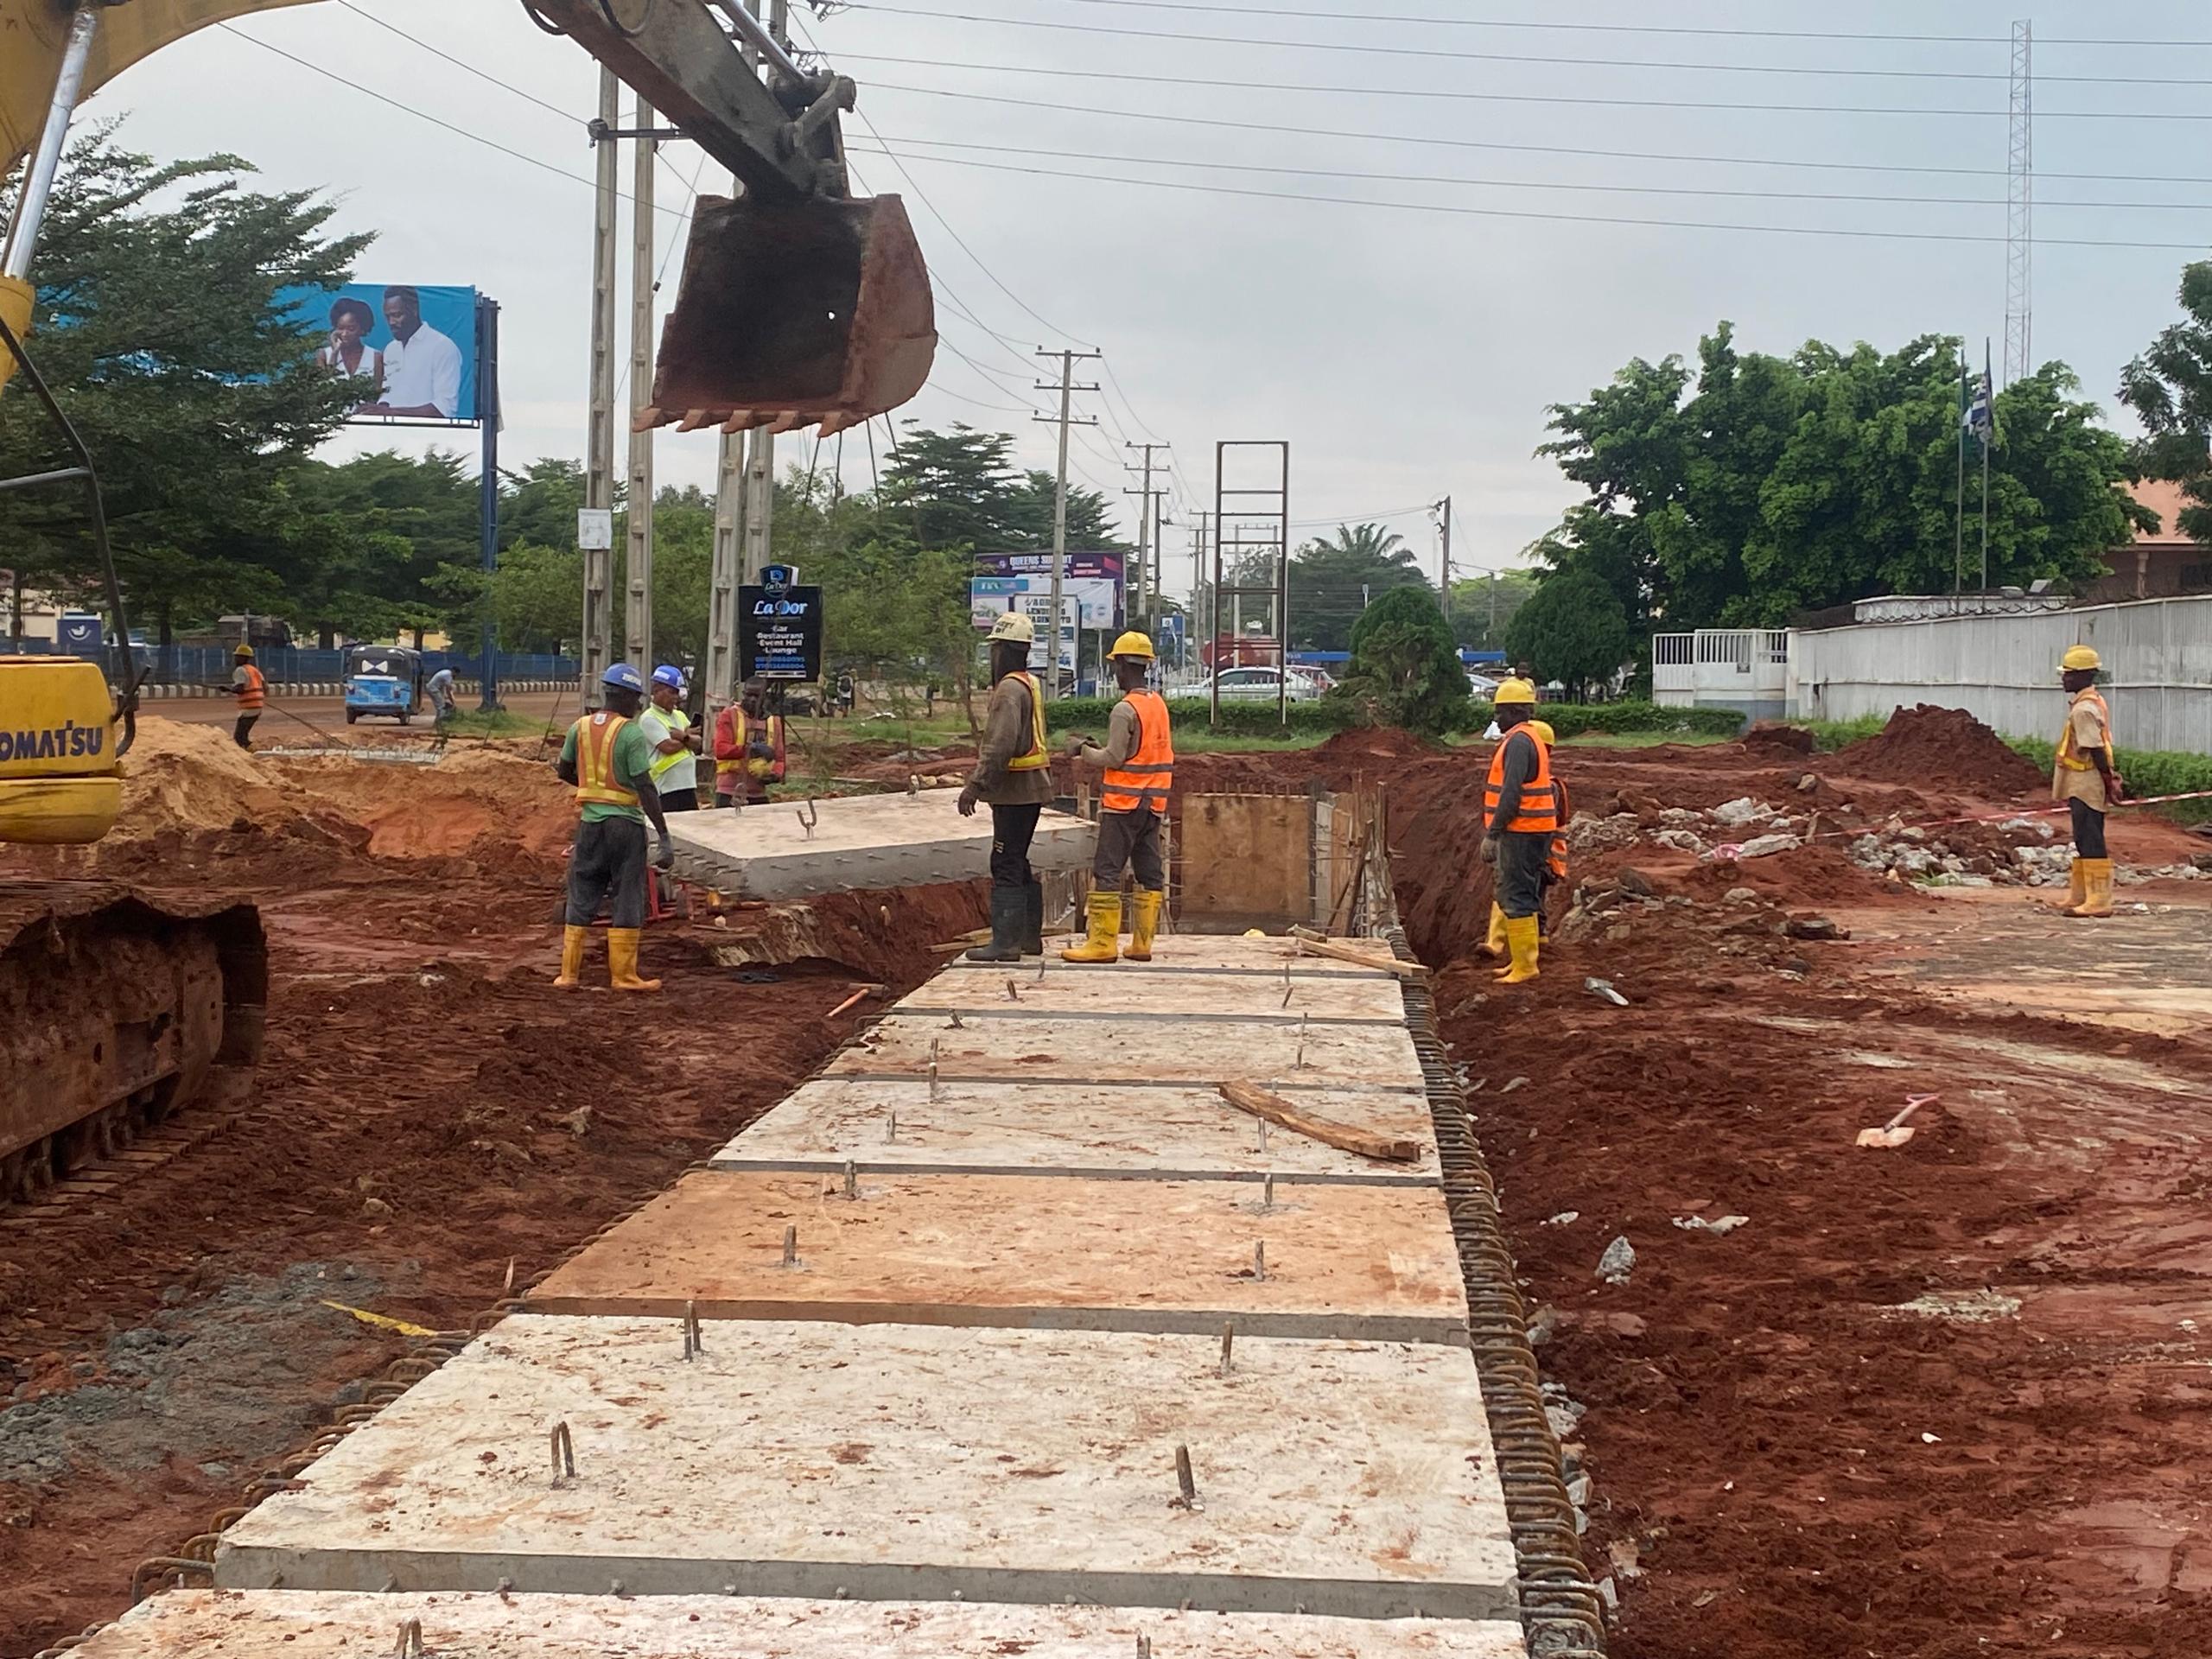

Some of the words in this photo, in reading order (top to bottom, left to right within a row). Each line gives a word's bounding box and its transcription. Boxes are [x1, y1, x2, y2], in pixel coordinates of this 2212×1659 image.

[753, 600, 774, 615] La
[775, 600, 808, 615] Dor
[0, 720, 103, 761] OMATSU
